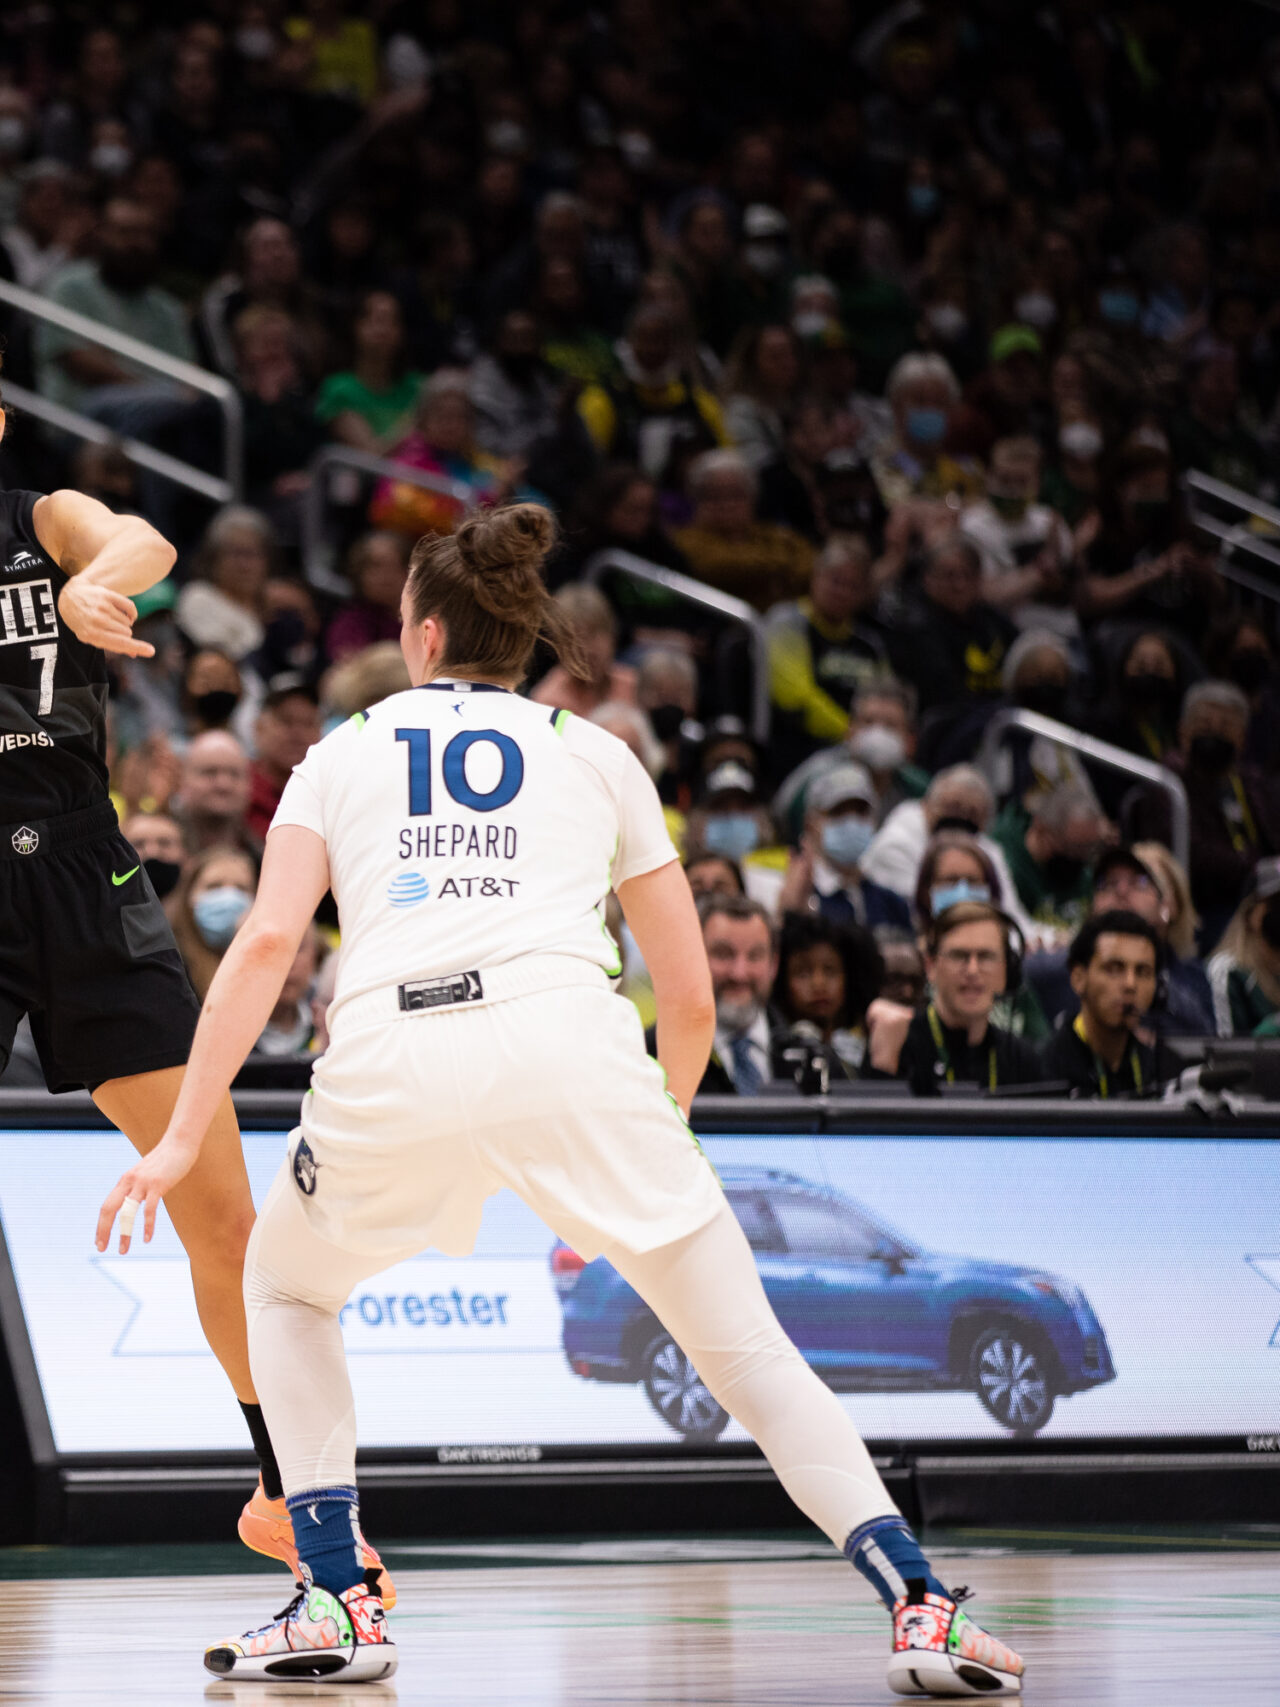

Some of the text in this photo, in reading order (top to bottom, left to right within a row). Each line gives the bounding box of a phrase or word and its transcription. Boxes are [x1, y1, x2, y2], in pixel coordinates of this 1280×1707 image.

[4, 558, 43, 572] SYMETRA
[30, 643, 58, 716] 7
[395, 728, 524, 816] 10
[399, 824, 517, 860] SHEPARD
[438, 877, 520, 899] AT&T
